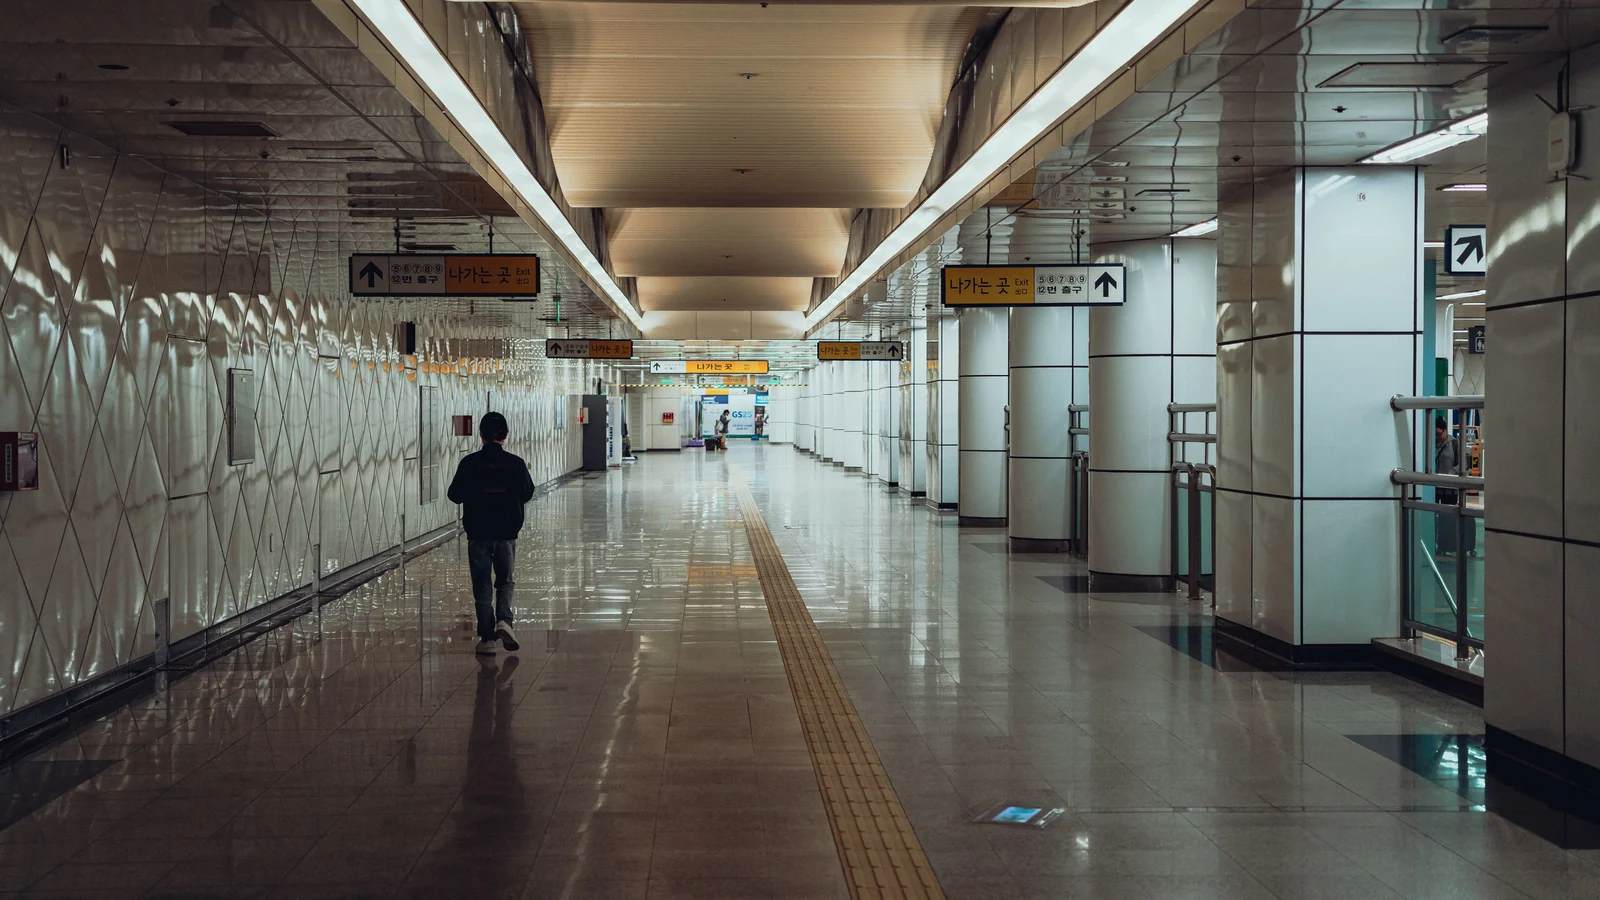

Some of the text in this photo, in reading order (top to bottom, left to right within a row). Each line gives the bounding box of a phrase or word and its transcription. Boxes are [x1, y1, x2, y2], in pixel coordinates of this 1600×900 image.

[450, 266, 511, 284] 나가는 곳
[516, 268, 531, 276] Exit
[417, 275, 439, 284] 출구
[1014, 278, 1029, 286] Exit
[950, 278, 1010, 294] 나가는 곳
[1062, 286, 1083, 295] 출구
[592, 344, 612, 354] 나가는
[614, 344, 620, 354] 곳
[820, 346, 840, 355] 나가는
[842, 346, 849, 355] 곳
